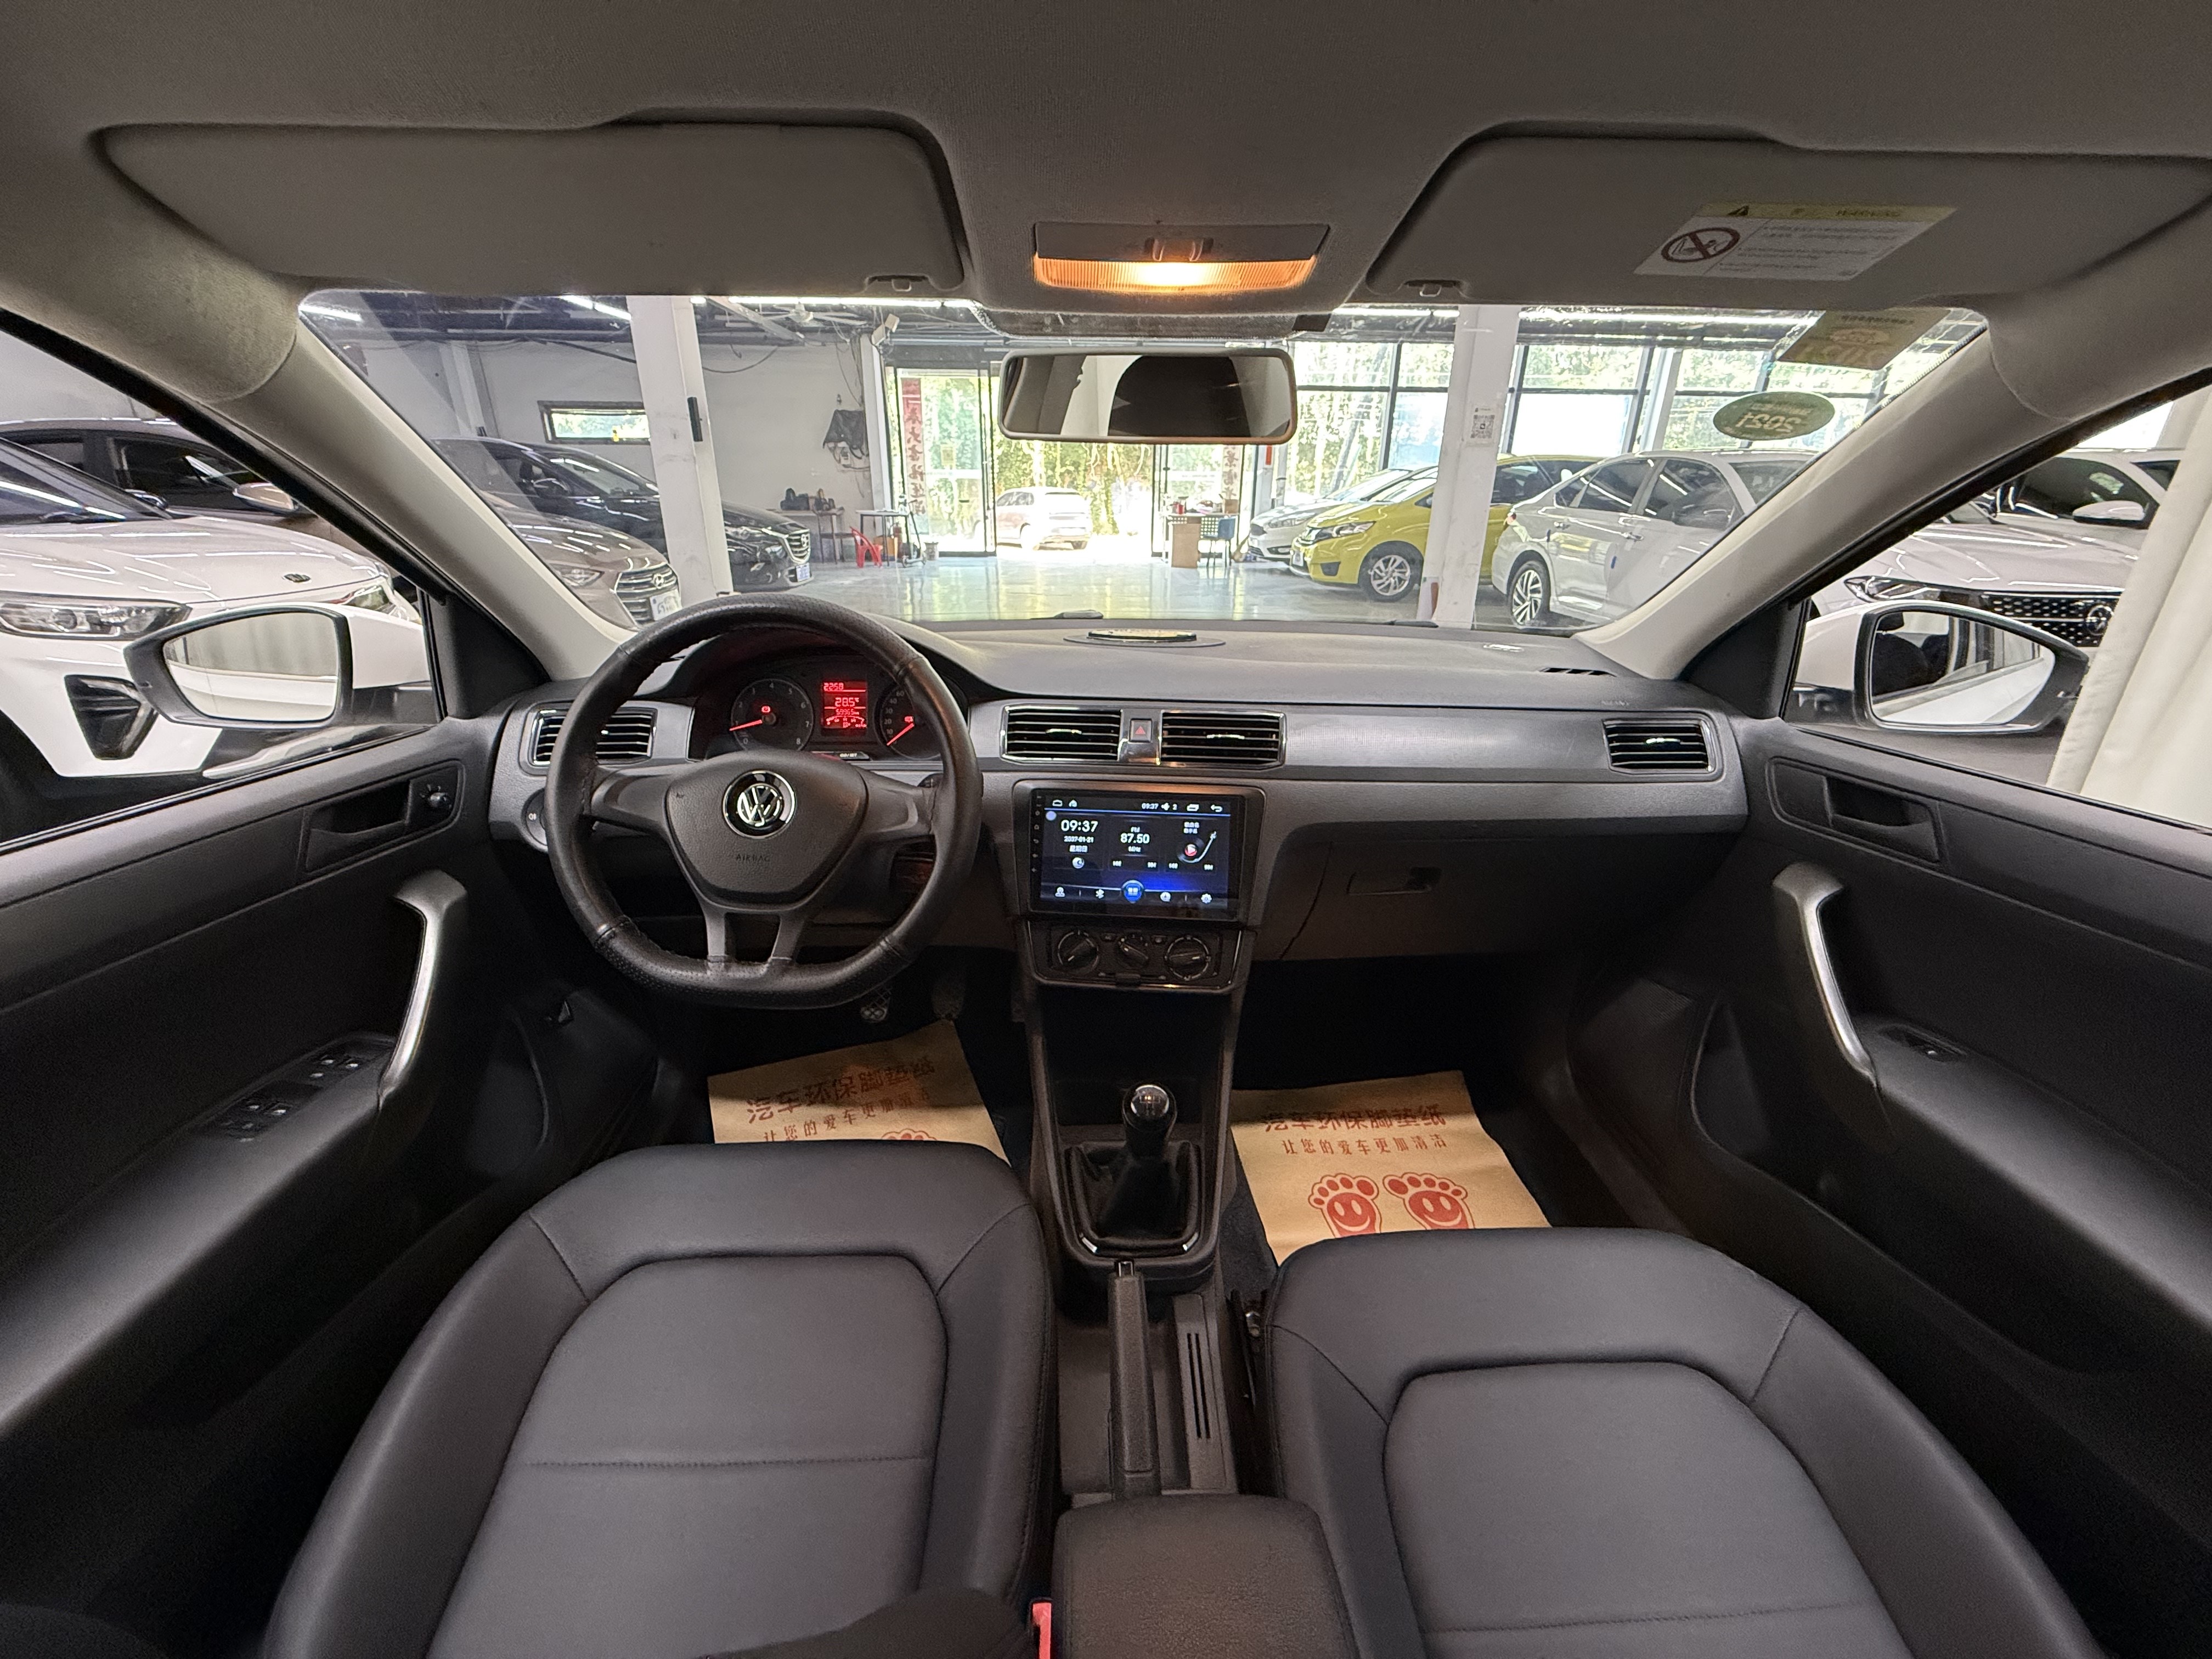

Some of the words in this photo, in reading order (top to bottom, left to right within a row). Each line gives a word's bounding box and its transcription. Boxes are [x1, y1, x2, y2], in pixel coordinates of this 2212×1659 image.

[1061, 820, 1098, 832] 09:37
[1120, 833, 1150, 844] 87.50
[736, 854, 770, 862] AIRBAG
[1263, 1103, 1447, 1132] 汽车环保脚垫纸
[1282, 1134, 1448, 1155] 让您的爱车更加清洁
